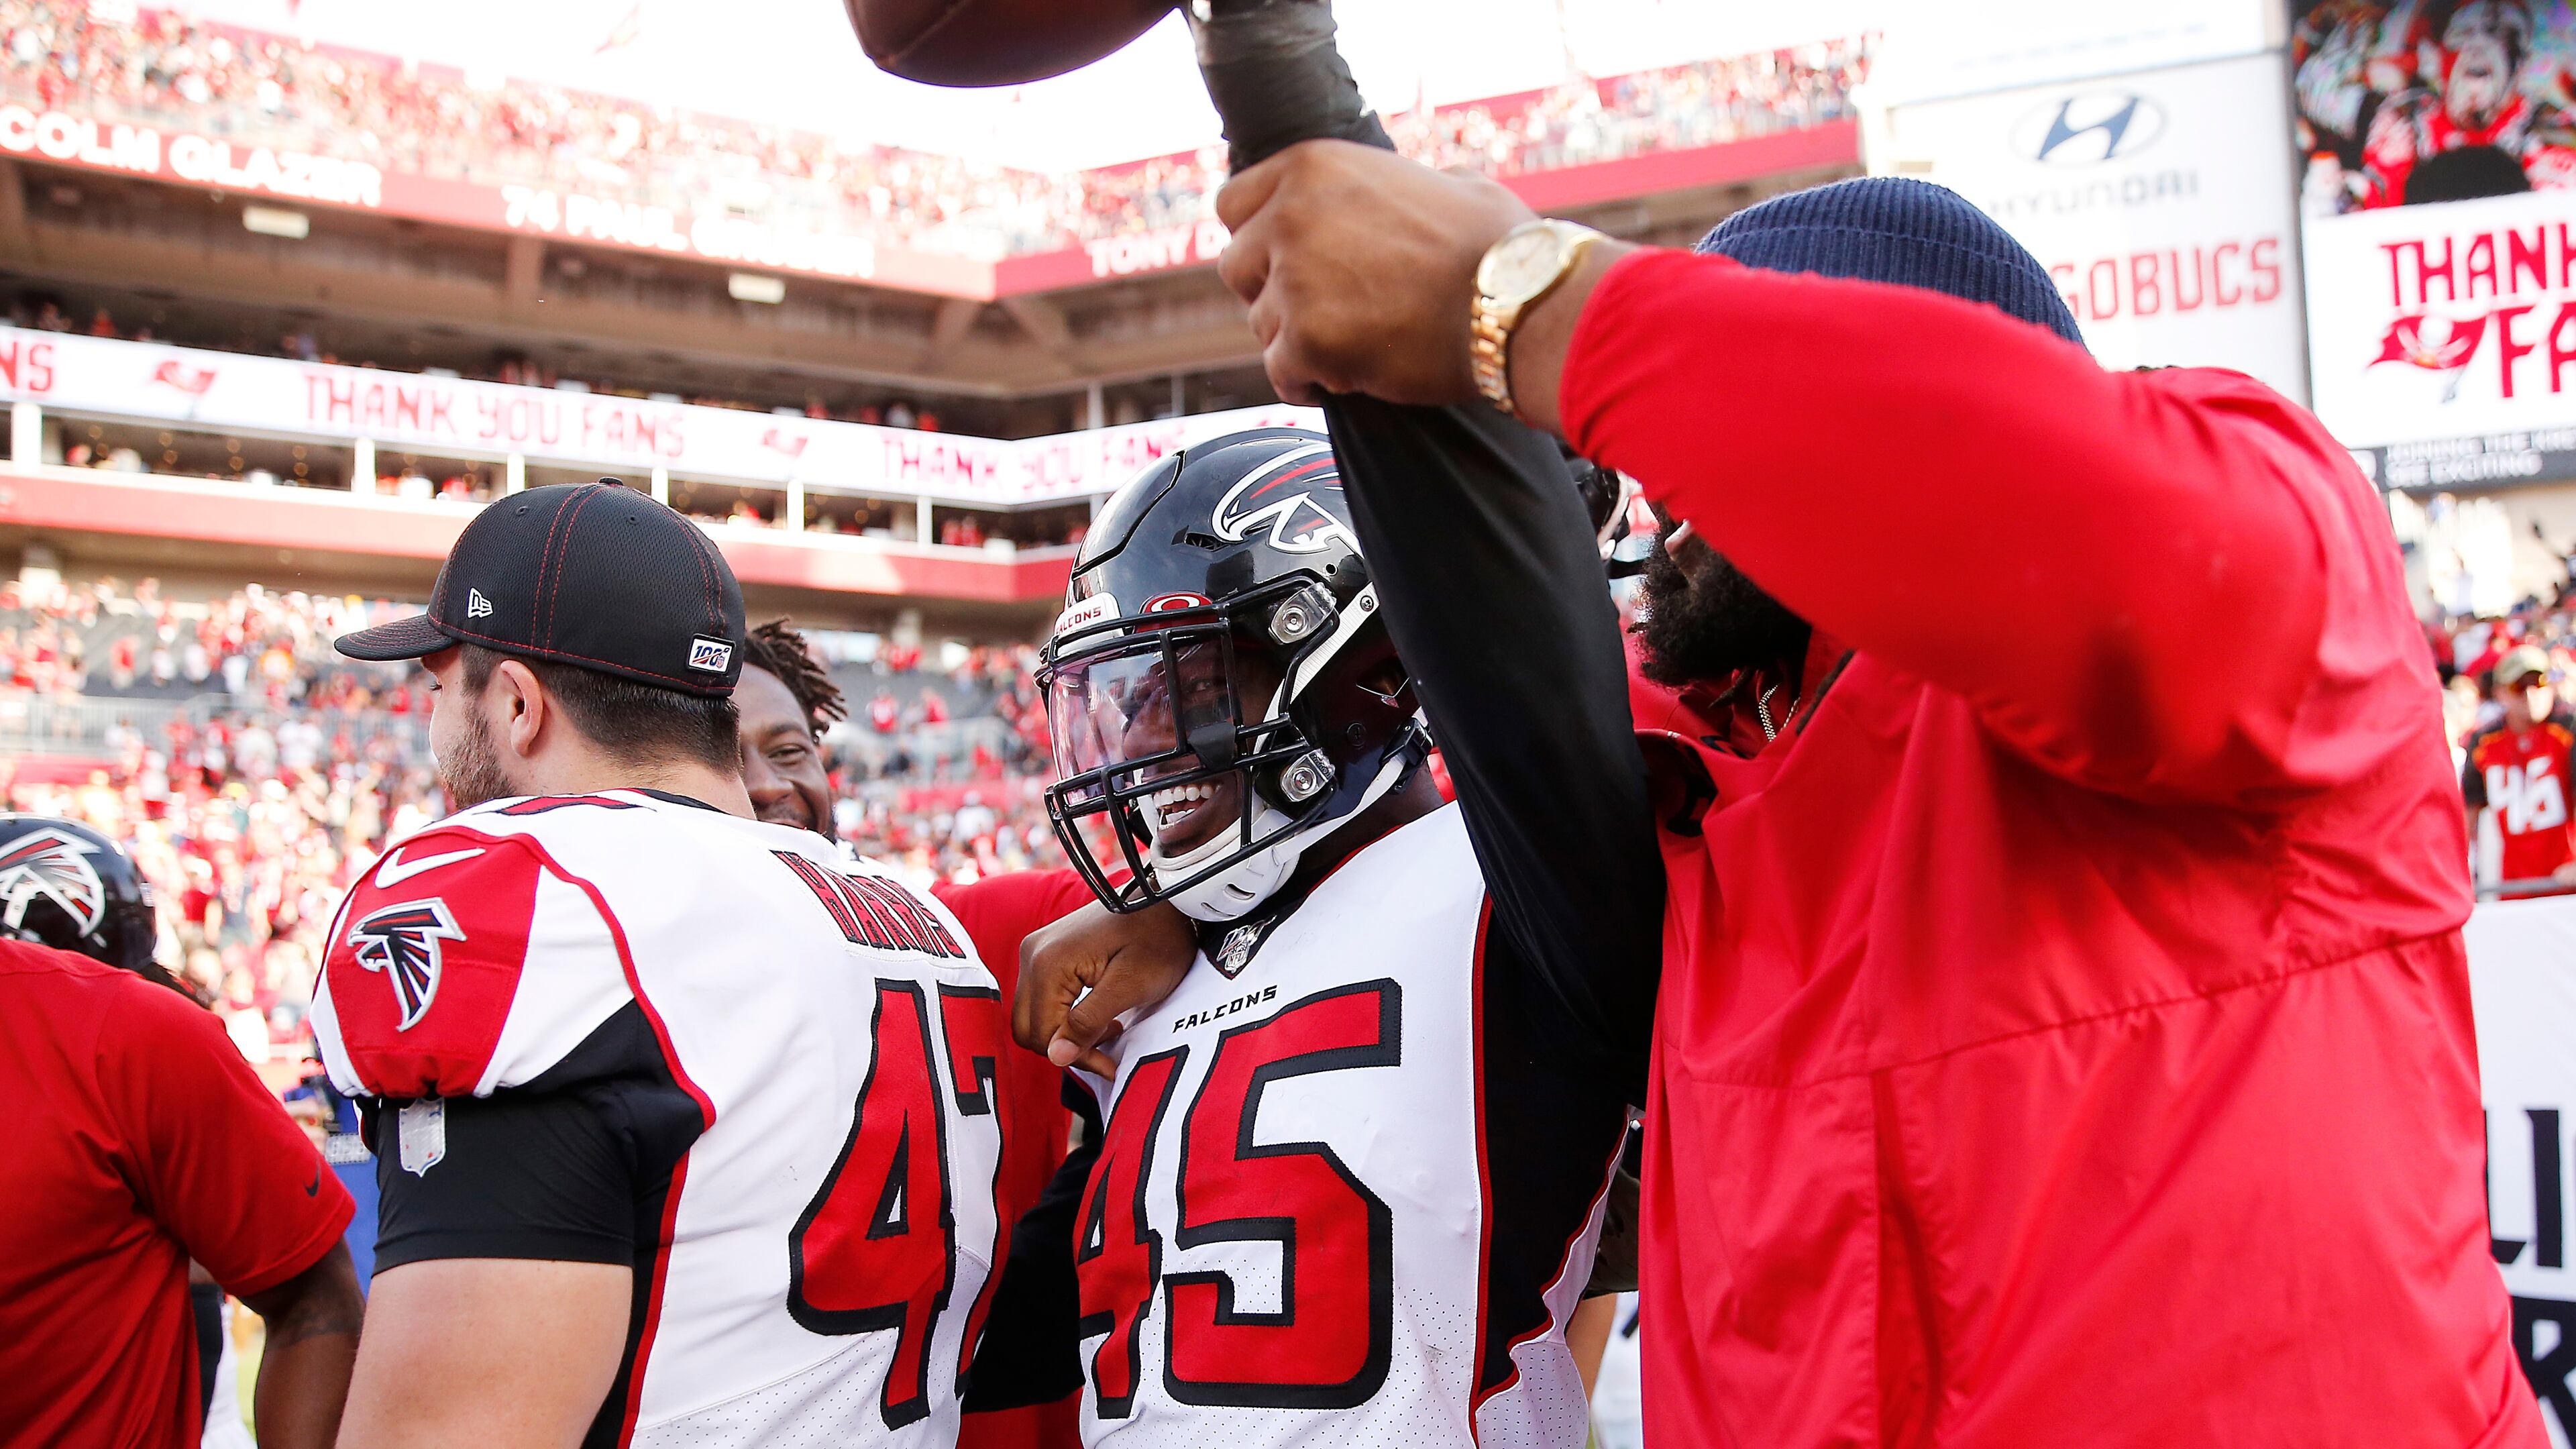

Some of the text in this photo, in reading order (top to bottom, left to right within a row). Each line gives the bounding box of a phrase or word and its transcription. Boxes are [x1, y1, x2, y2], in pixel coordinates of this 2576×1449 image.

[169, 135, 382, 207] GLAZER
[1988, 168, 2200, 218] HYUNDAI
[1084, 223, 1195, 278] TONY
[303, 370, 686, 459] THANK YOU FANS
[879, 438, 1002, 488] THANK
[1020, 443, 1083, 491] YOU
[1055, 606, 1102, 635] FALCONS
[2485, 755, 2568, 836] 46
[1172, 984, 1278, 1034] FALCONS
[787, 977, 1005, 1430] 47
[1075, 977, 1402, 1419] 45
